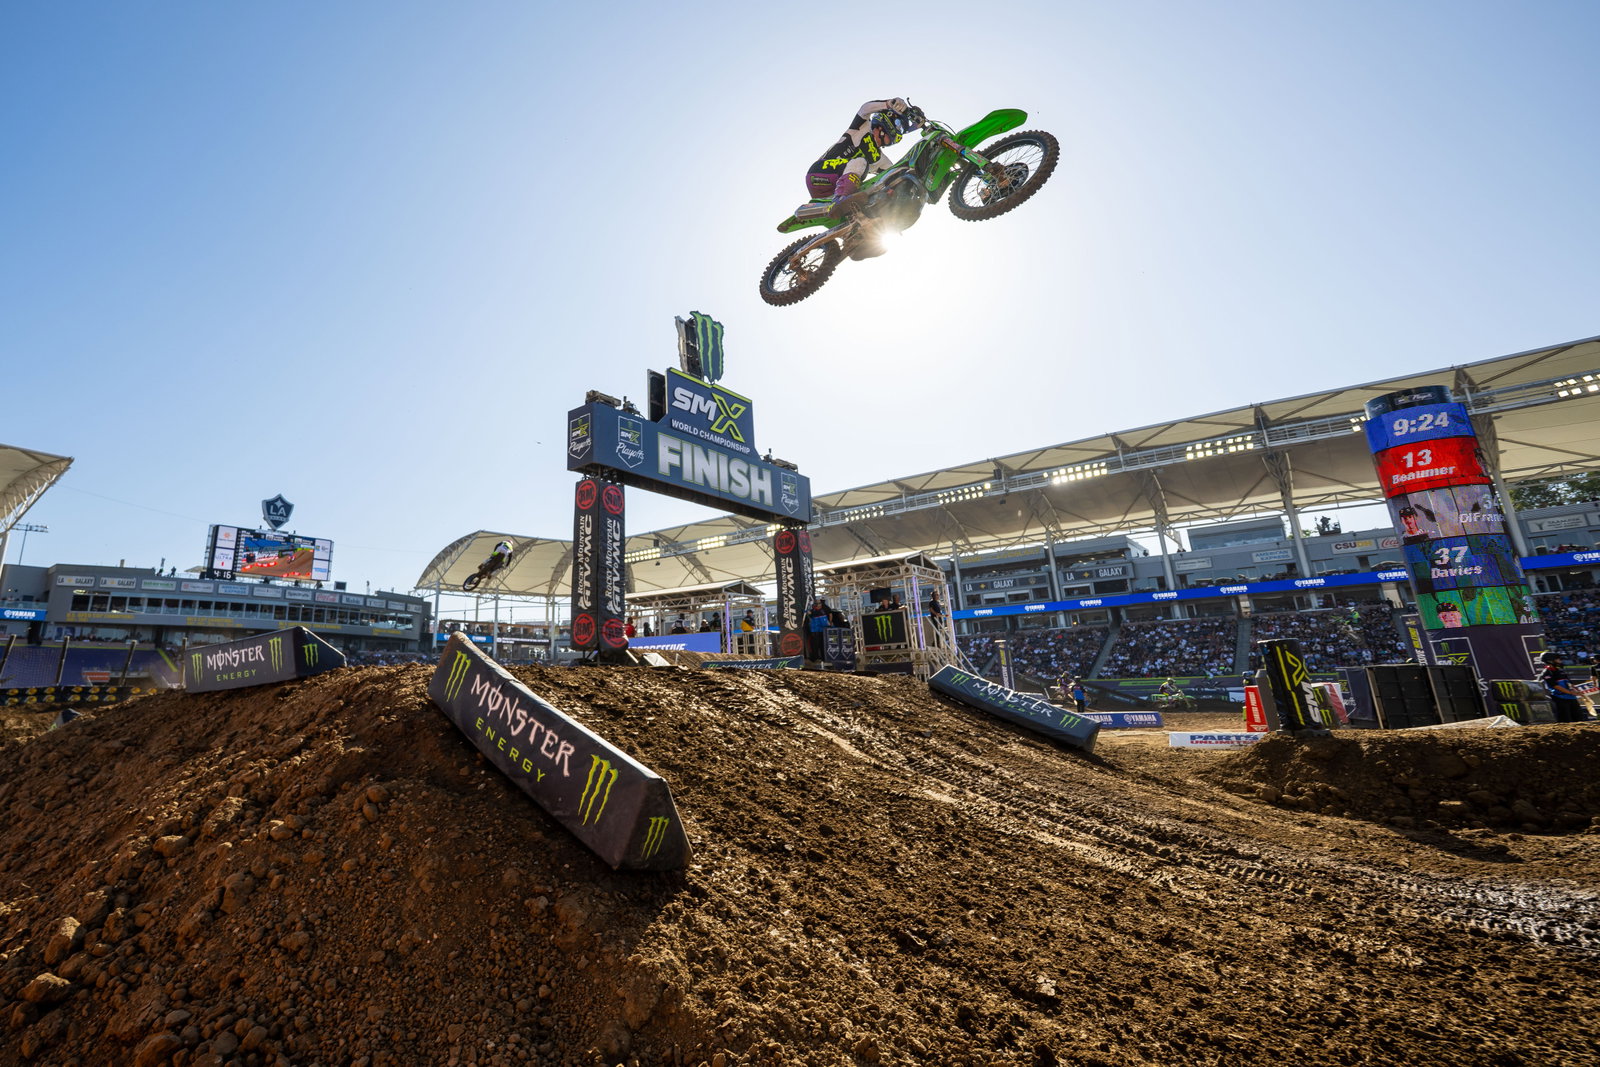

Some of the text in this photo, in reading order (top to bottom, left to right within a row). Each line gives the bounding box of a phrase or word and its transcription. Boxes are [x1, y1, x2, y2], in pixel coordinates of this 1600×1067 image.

[672, 387, 746, 443] SMX
[1393, 412, 1449, 436] 9:24
[572, 424, 589, 438] SMX
[620, 430, 640, 444] SMX
[671, 419, 751, 454] WORLD CHAMPIONSHIP
[616, 442, 645, 460] Playoffs
[1402, 449, 1432, 468] 13
[657, 432, 774, 507] FINISH
[1392, 466, 1456, 485] Beaumer
[270, 505, 286, 516] LA
[577, 515, 585, 564] MOUNTAIN
[605, 517, 613, 568] MOUNTAIN
[1435, 546, 1468, 565] 37
[1066, 566, 1123, 581] LA GALAXY
[1431, 565, 1482, 579] Davies
[965, 579, 1014, 592] LA GALAXY
[216, 669, 257, 682] ENERGY
[1130, 714, 1157, 722] YAMAHA
[475, 717, 546, 783] ENERGY
